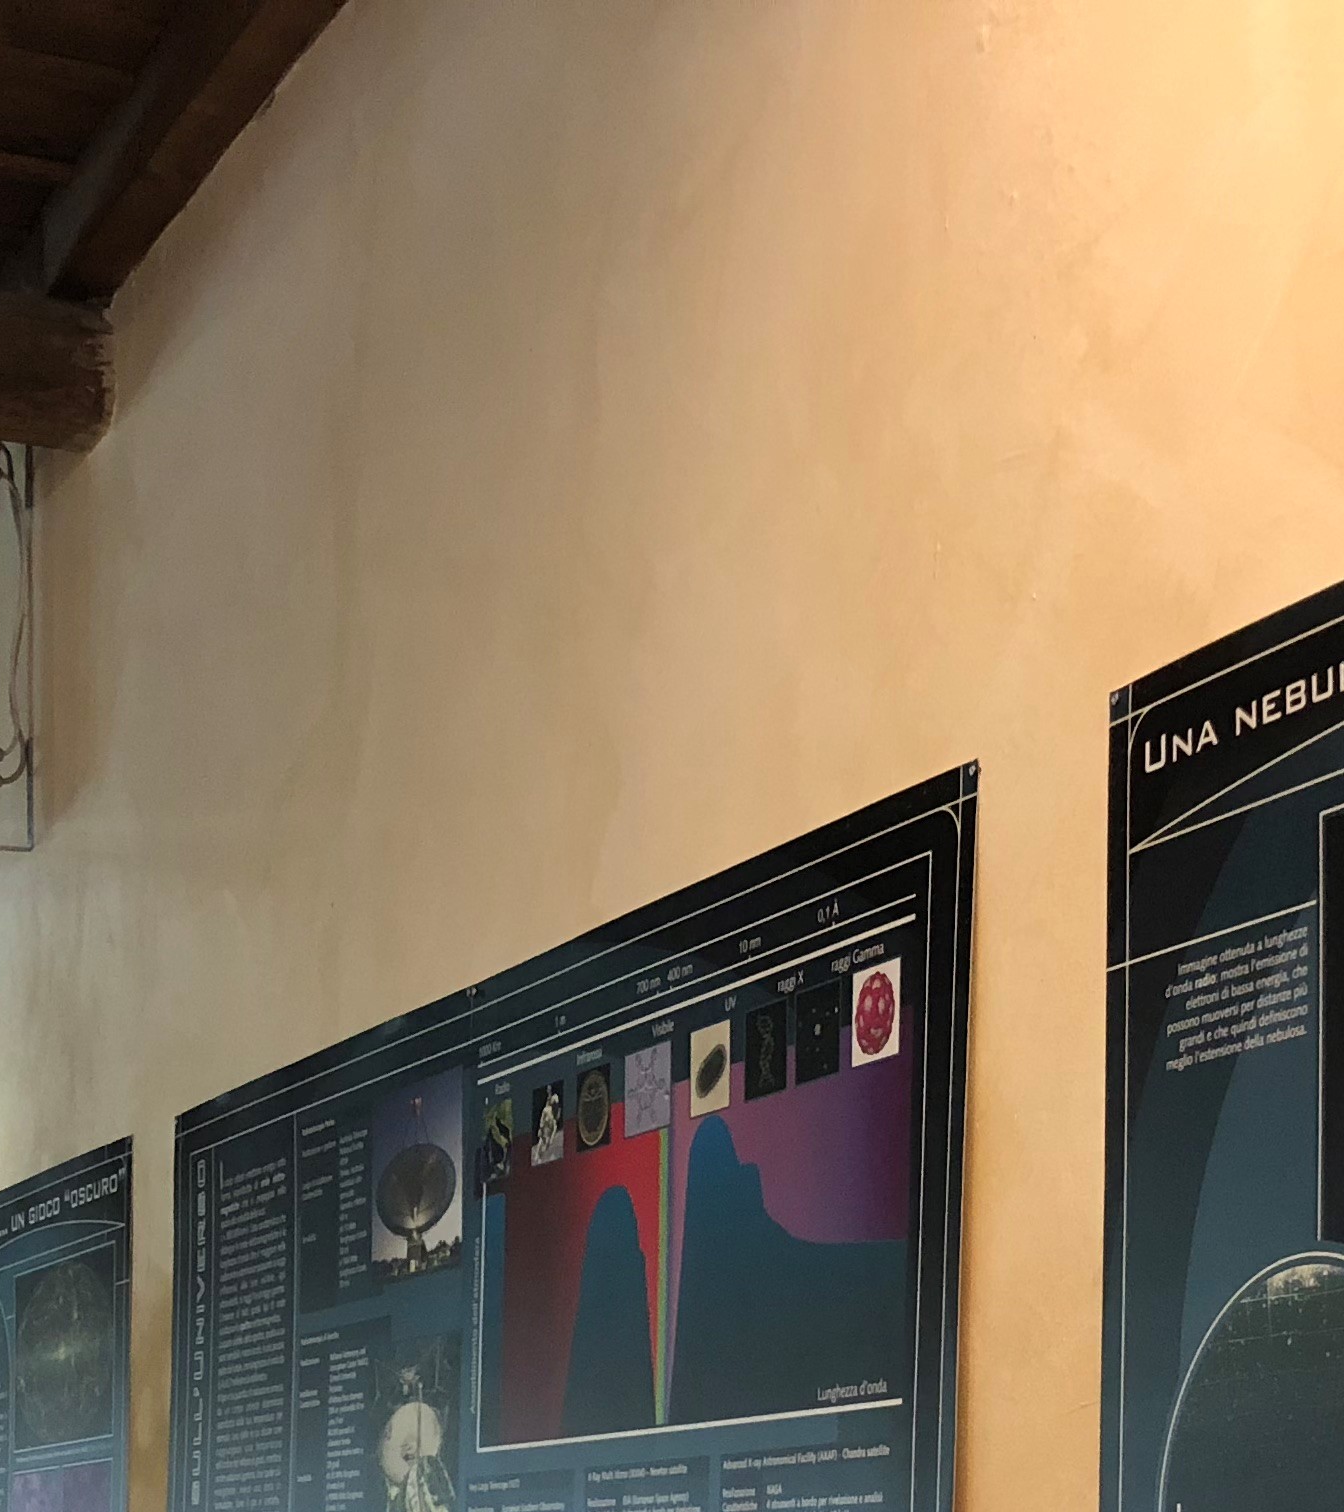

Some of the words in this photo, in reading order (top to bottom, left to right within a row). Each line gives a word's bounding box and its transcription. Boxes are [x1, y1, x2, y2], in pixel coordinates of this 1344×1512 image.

[1144, 719, 1218, 773] UNA
[738, 938, 748, 954] 10
[748, 936, 761, 950] nm
[830, 953, 851, 974] raggi
[851, 942, 884, 964] Gamma
[776, 975, 796, 994] raggi
[797, 969, 803, 984] X
[724, 994, 737, 1012] UV
[10, 1211, 26, 1232] UN
[28, 1197, 61, 1225] GIOCO
[816, 1382, 858, 1403] Lunghezza
[858, 1377, 887, 1396] d'onda
